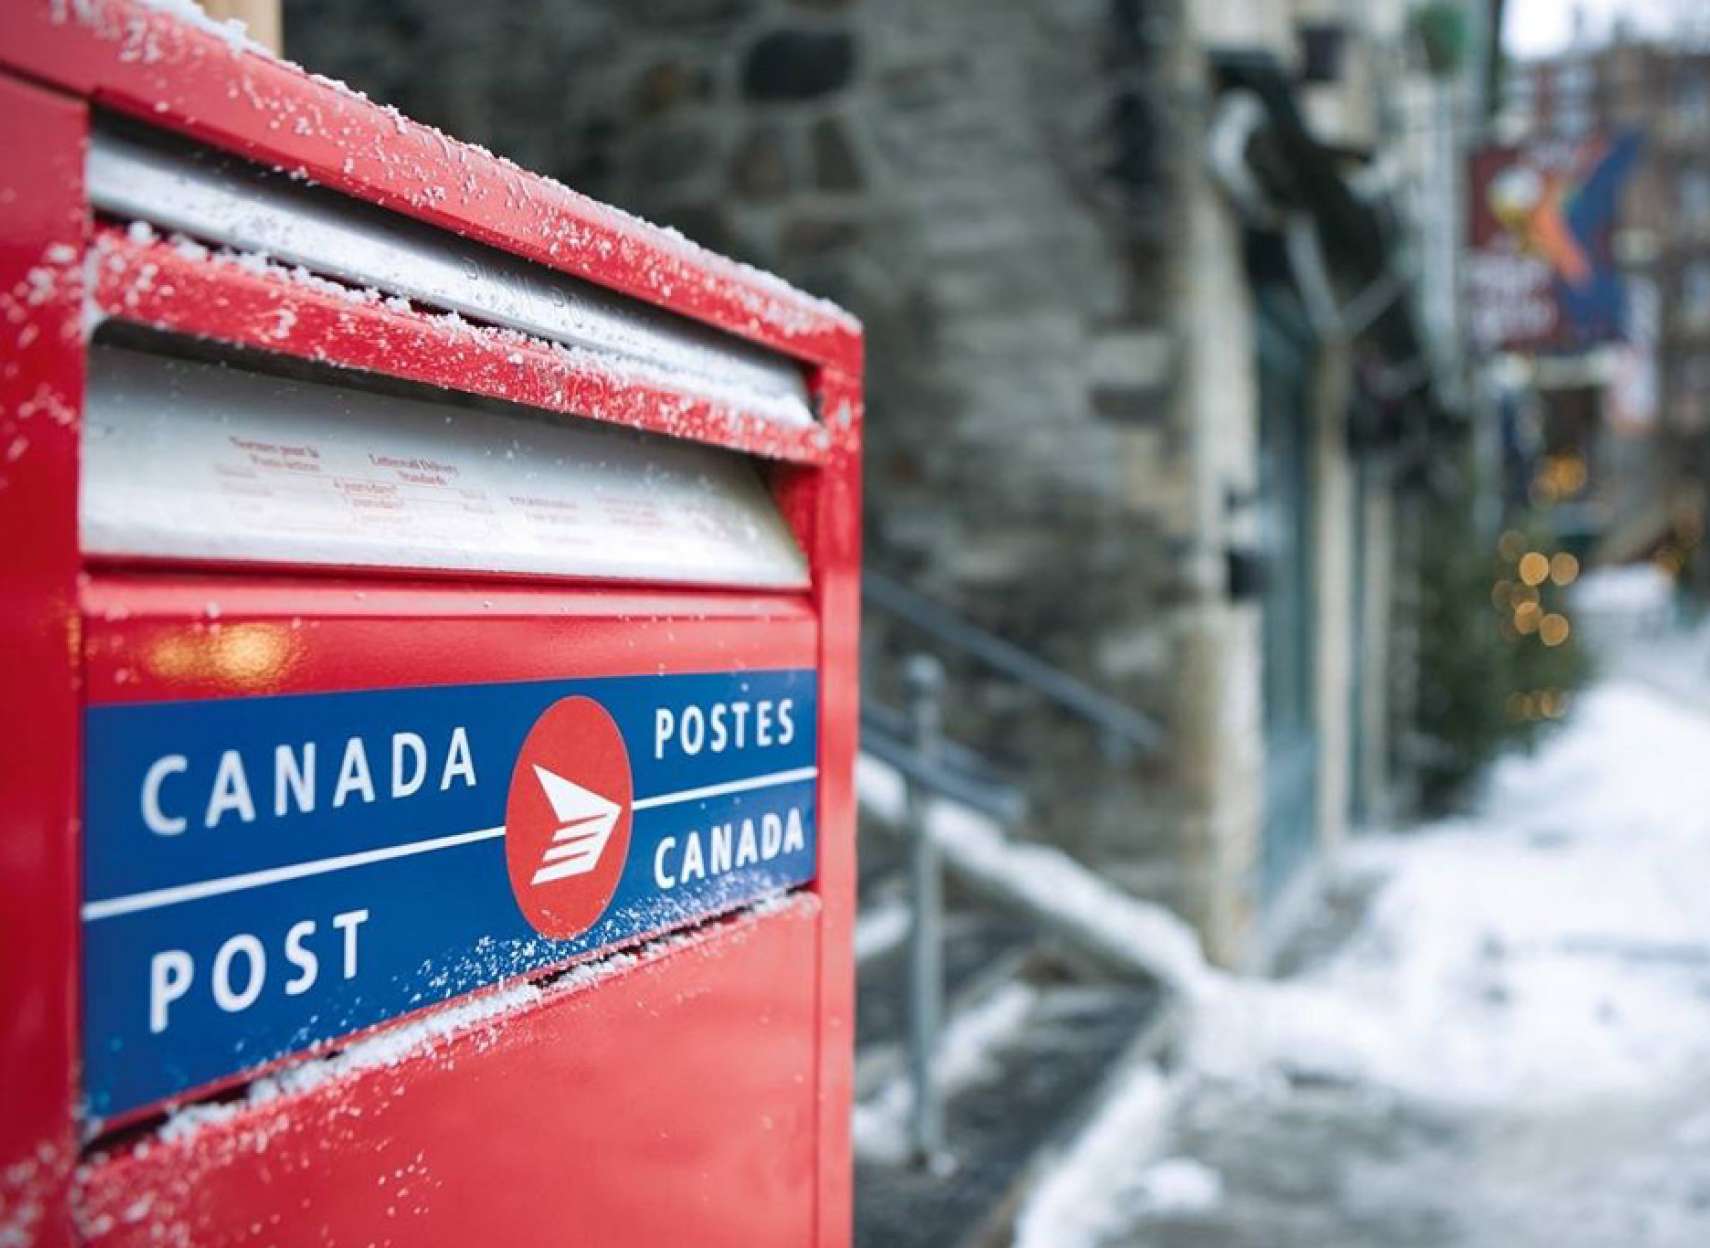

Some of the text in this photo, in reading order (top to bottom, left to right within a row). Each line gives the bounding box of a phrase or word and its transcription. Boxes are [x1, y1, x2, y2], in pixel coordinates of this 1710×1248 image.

[655, 698, 794, 759] POSTES
[141, 727, 477, 836] CANADA
[654, 807, 805, 889] CANADA
[149, 909, 370, 1034] POST
